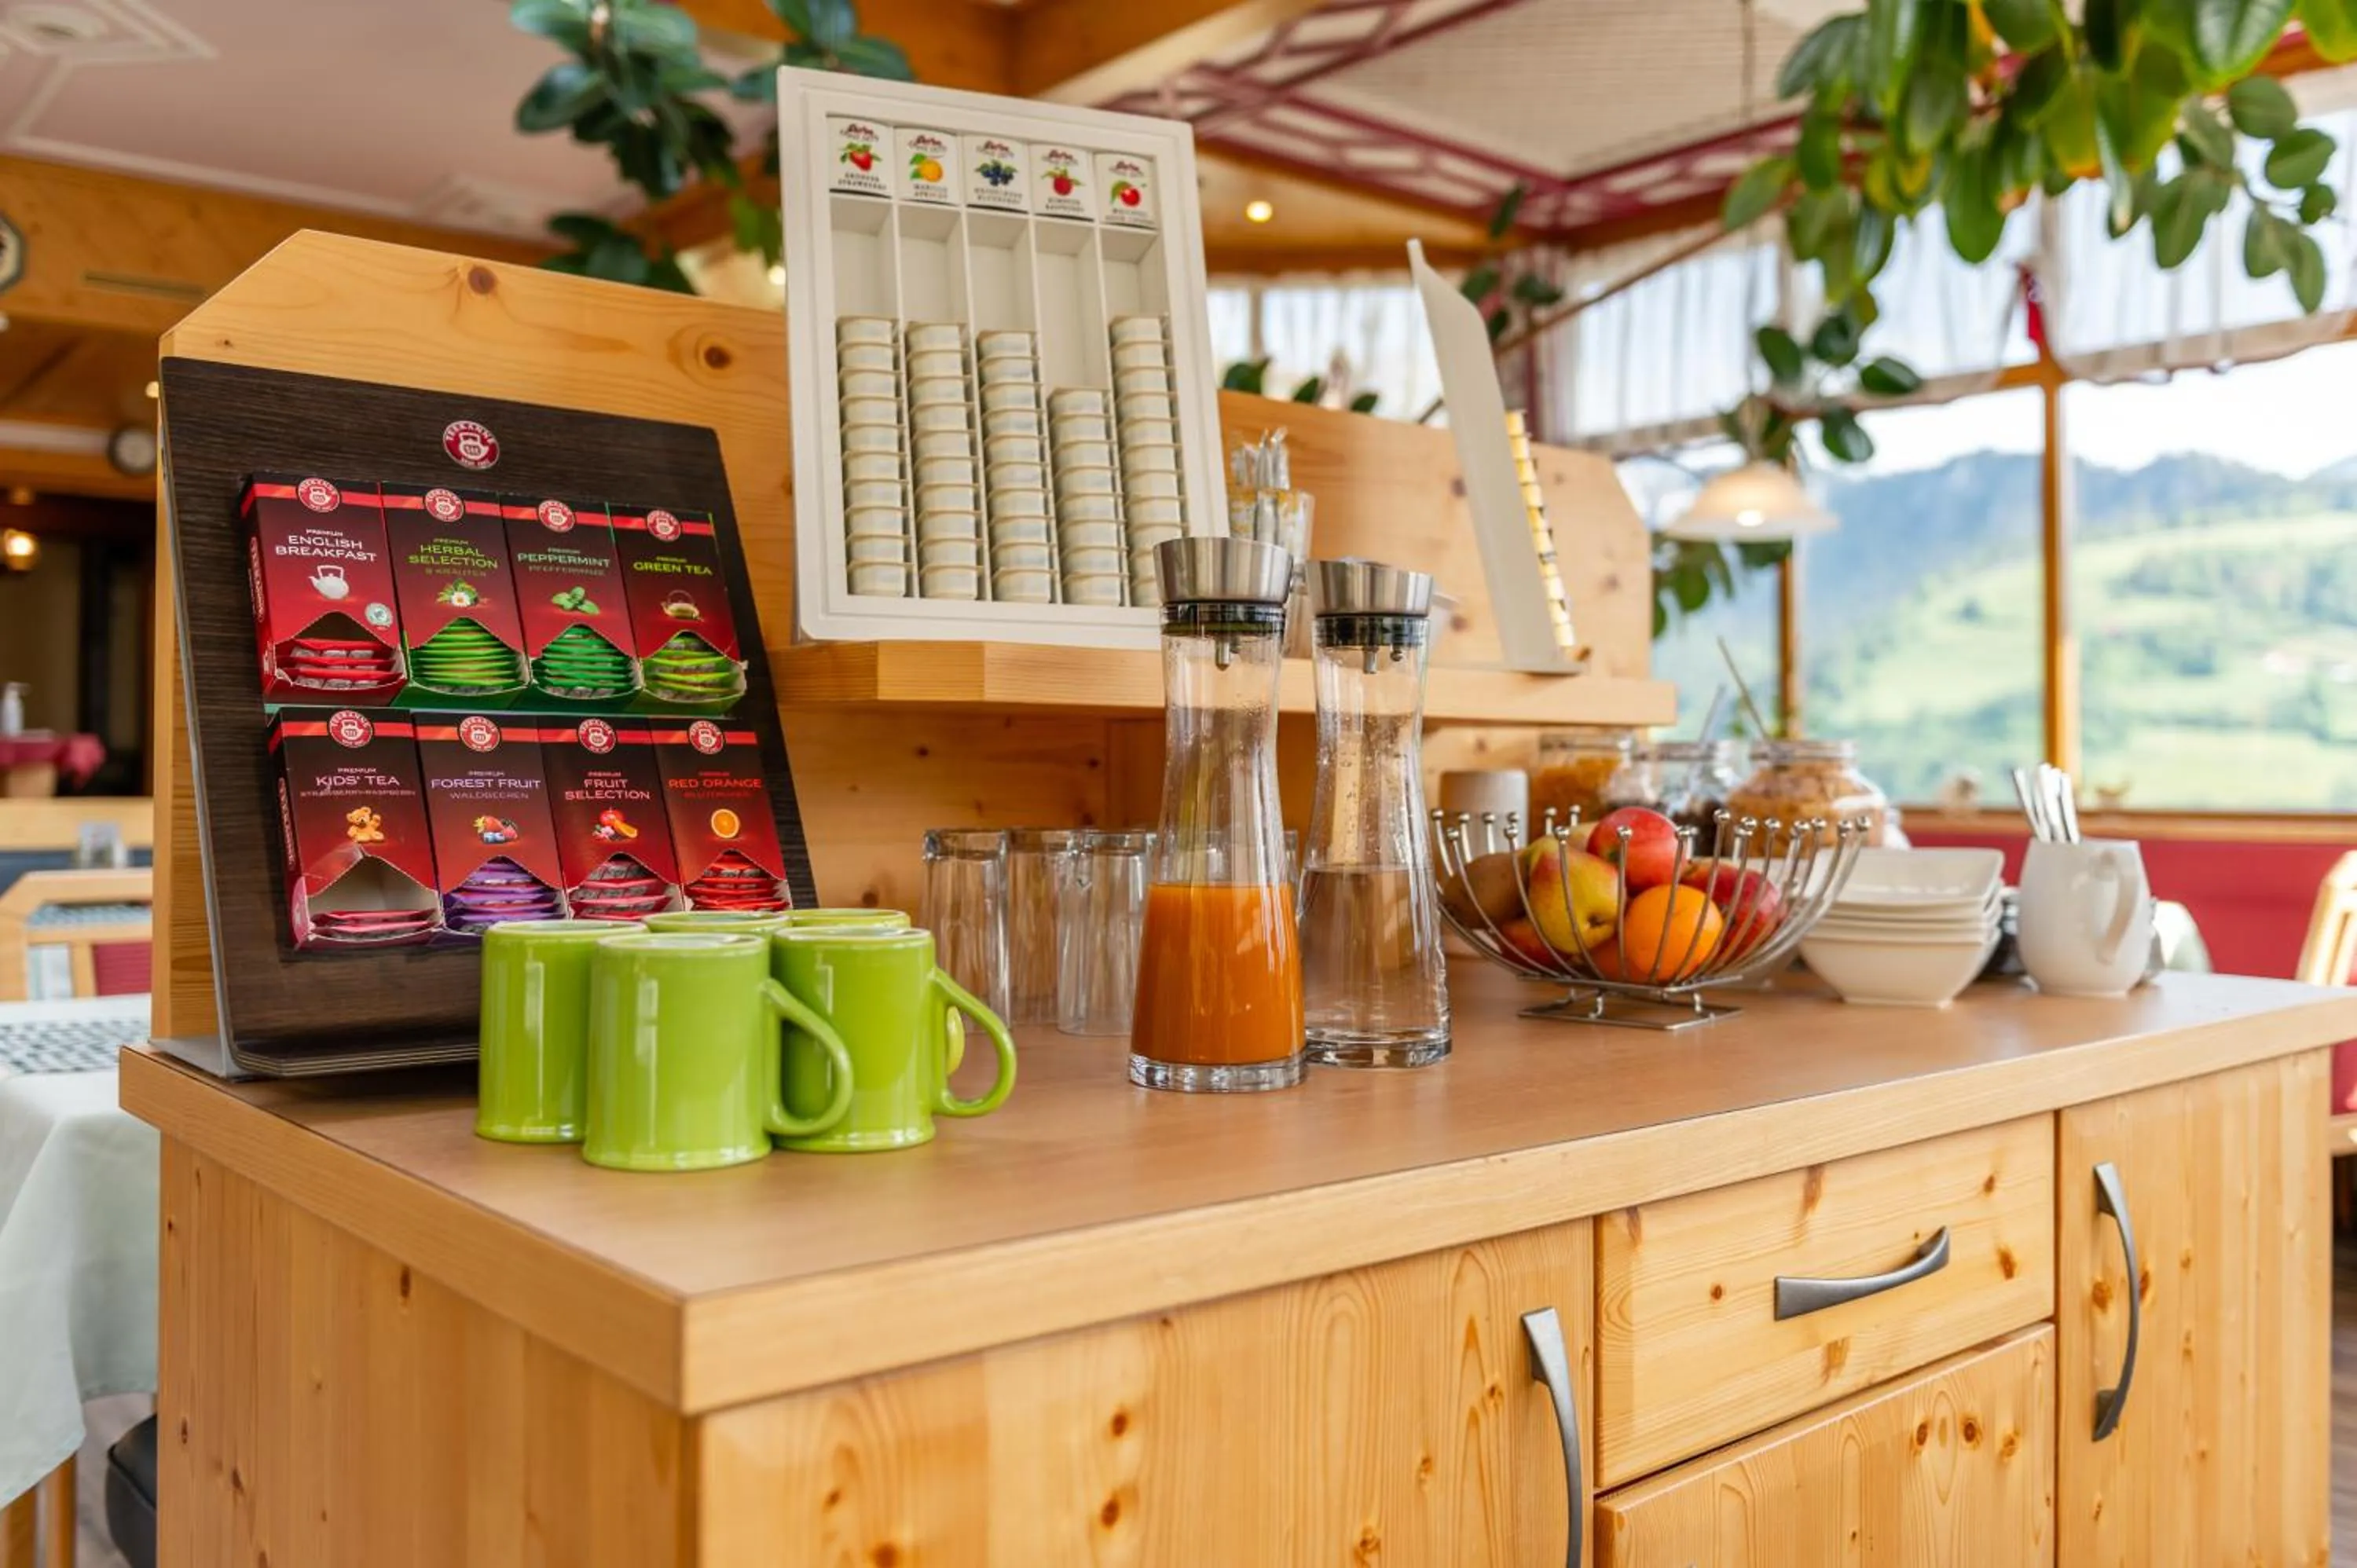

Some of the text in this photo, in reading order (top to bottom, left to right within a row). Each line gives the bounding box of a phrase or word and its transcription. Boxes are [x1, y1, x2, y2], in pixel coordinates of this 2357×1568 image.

[288, 535, 364, 549] ENGLISH
[275, 546, 377, 562] BREAKFAST
[420, 544, 486, 558] HERBAL
[408, 555, 499, 569] SELECTION
[517, 552, 610, 568] PEPPERMINT
[632, 561, 714, 576] GREEN TEA
[316, 775, 401, 788] KIDS' TEA
[431, 779, 541, 789] FOREST FRUIT
[584, 779, 629, 789] FRUIT
[668, 779, 762, 789] RED ORANGE
[565, 788, 651, 800] SELECTION
